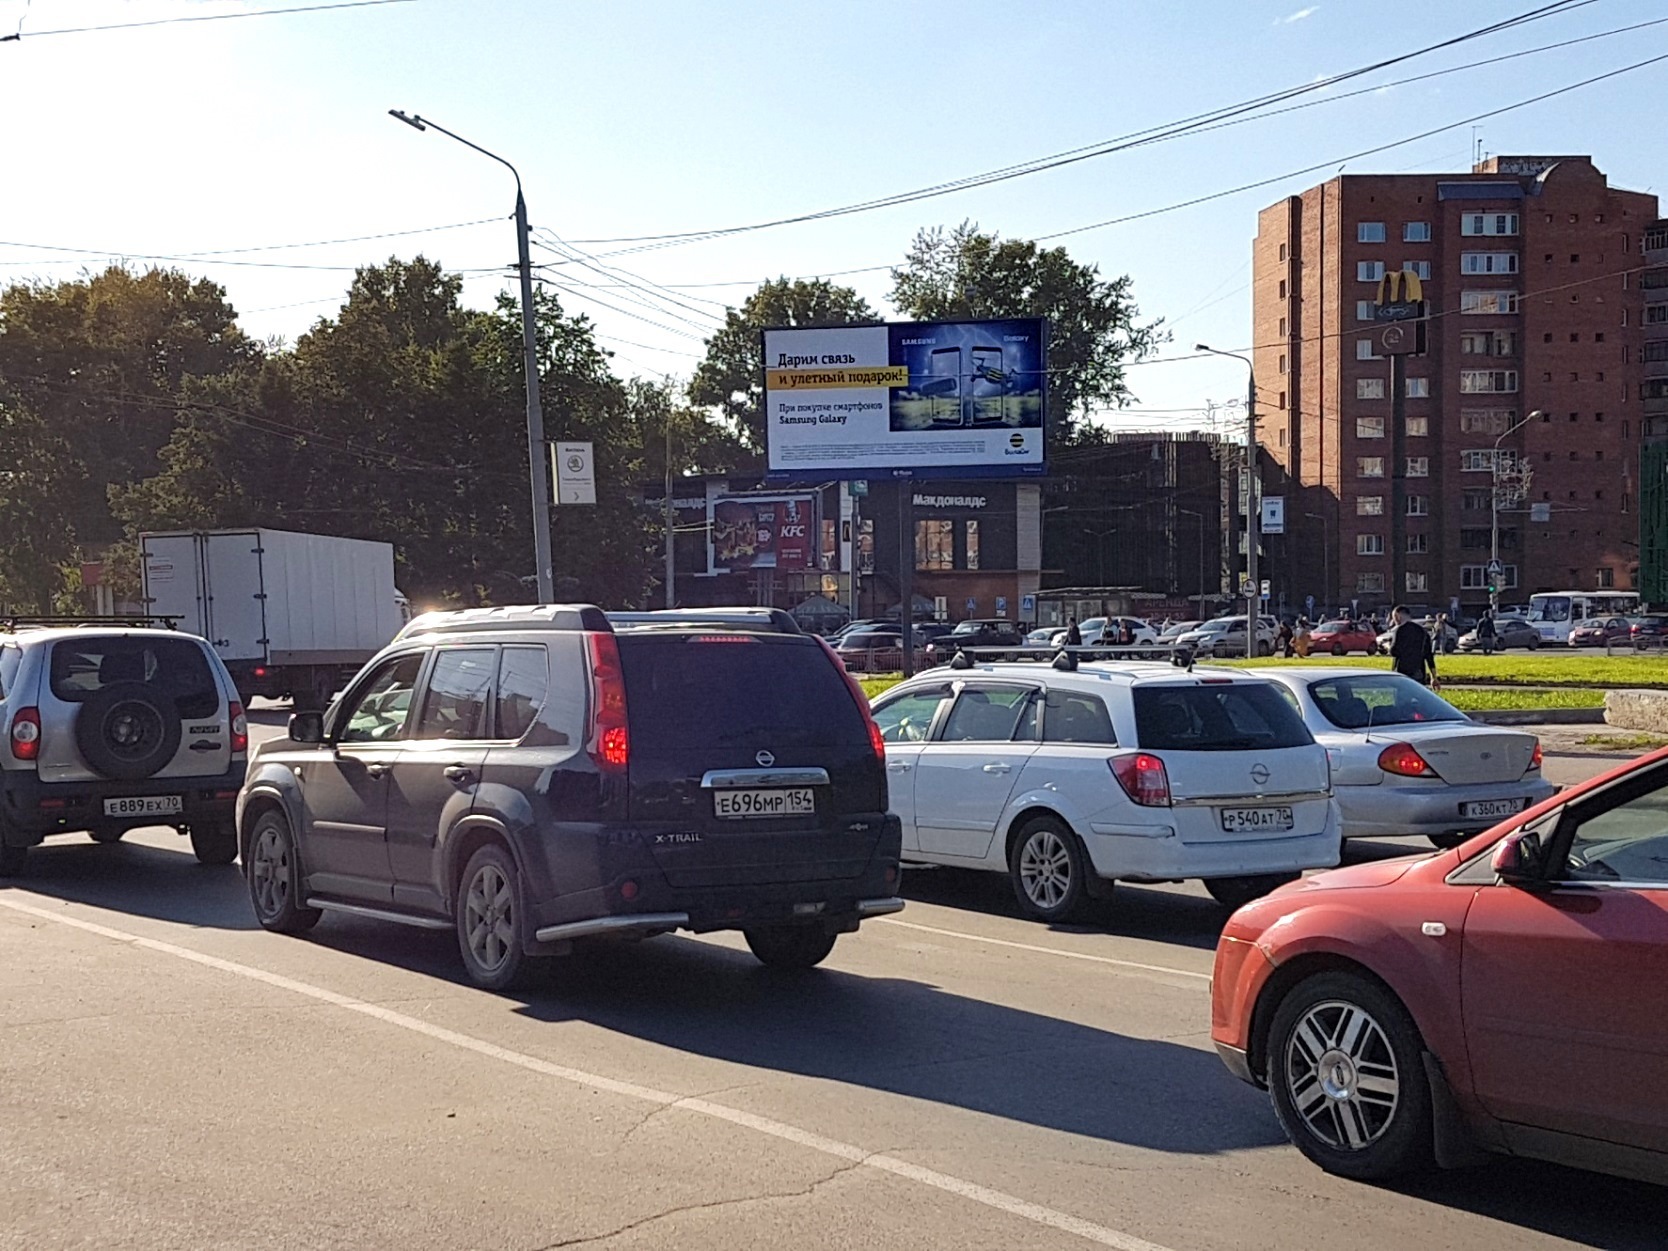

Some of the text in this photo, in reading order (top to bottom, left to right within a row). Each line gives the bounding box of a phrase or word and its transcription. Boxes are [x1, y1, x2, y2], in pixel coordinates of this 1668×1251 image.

[901, 338, 936, 346] SAMSUNG
[1003, 335, 1030, 343] Galaxy
[777, 353, 856, 369] Дарим связь
[778, 368, 903, 388] и улетный подарок!
[779, 402, 883, 415] При покупке смартфонов
[779, 414, 848, 426] Samsung Galaxy
[912, 494, 987, 508] Макдоналдс
[780, 525, 806, 538] KFC
[655, 833, 703, 843] X-TRAIL
